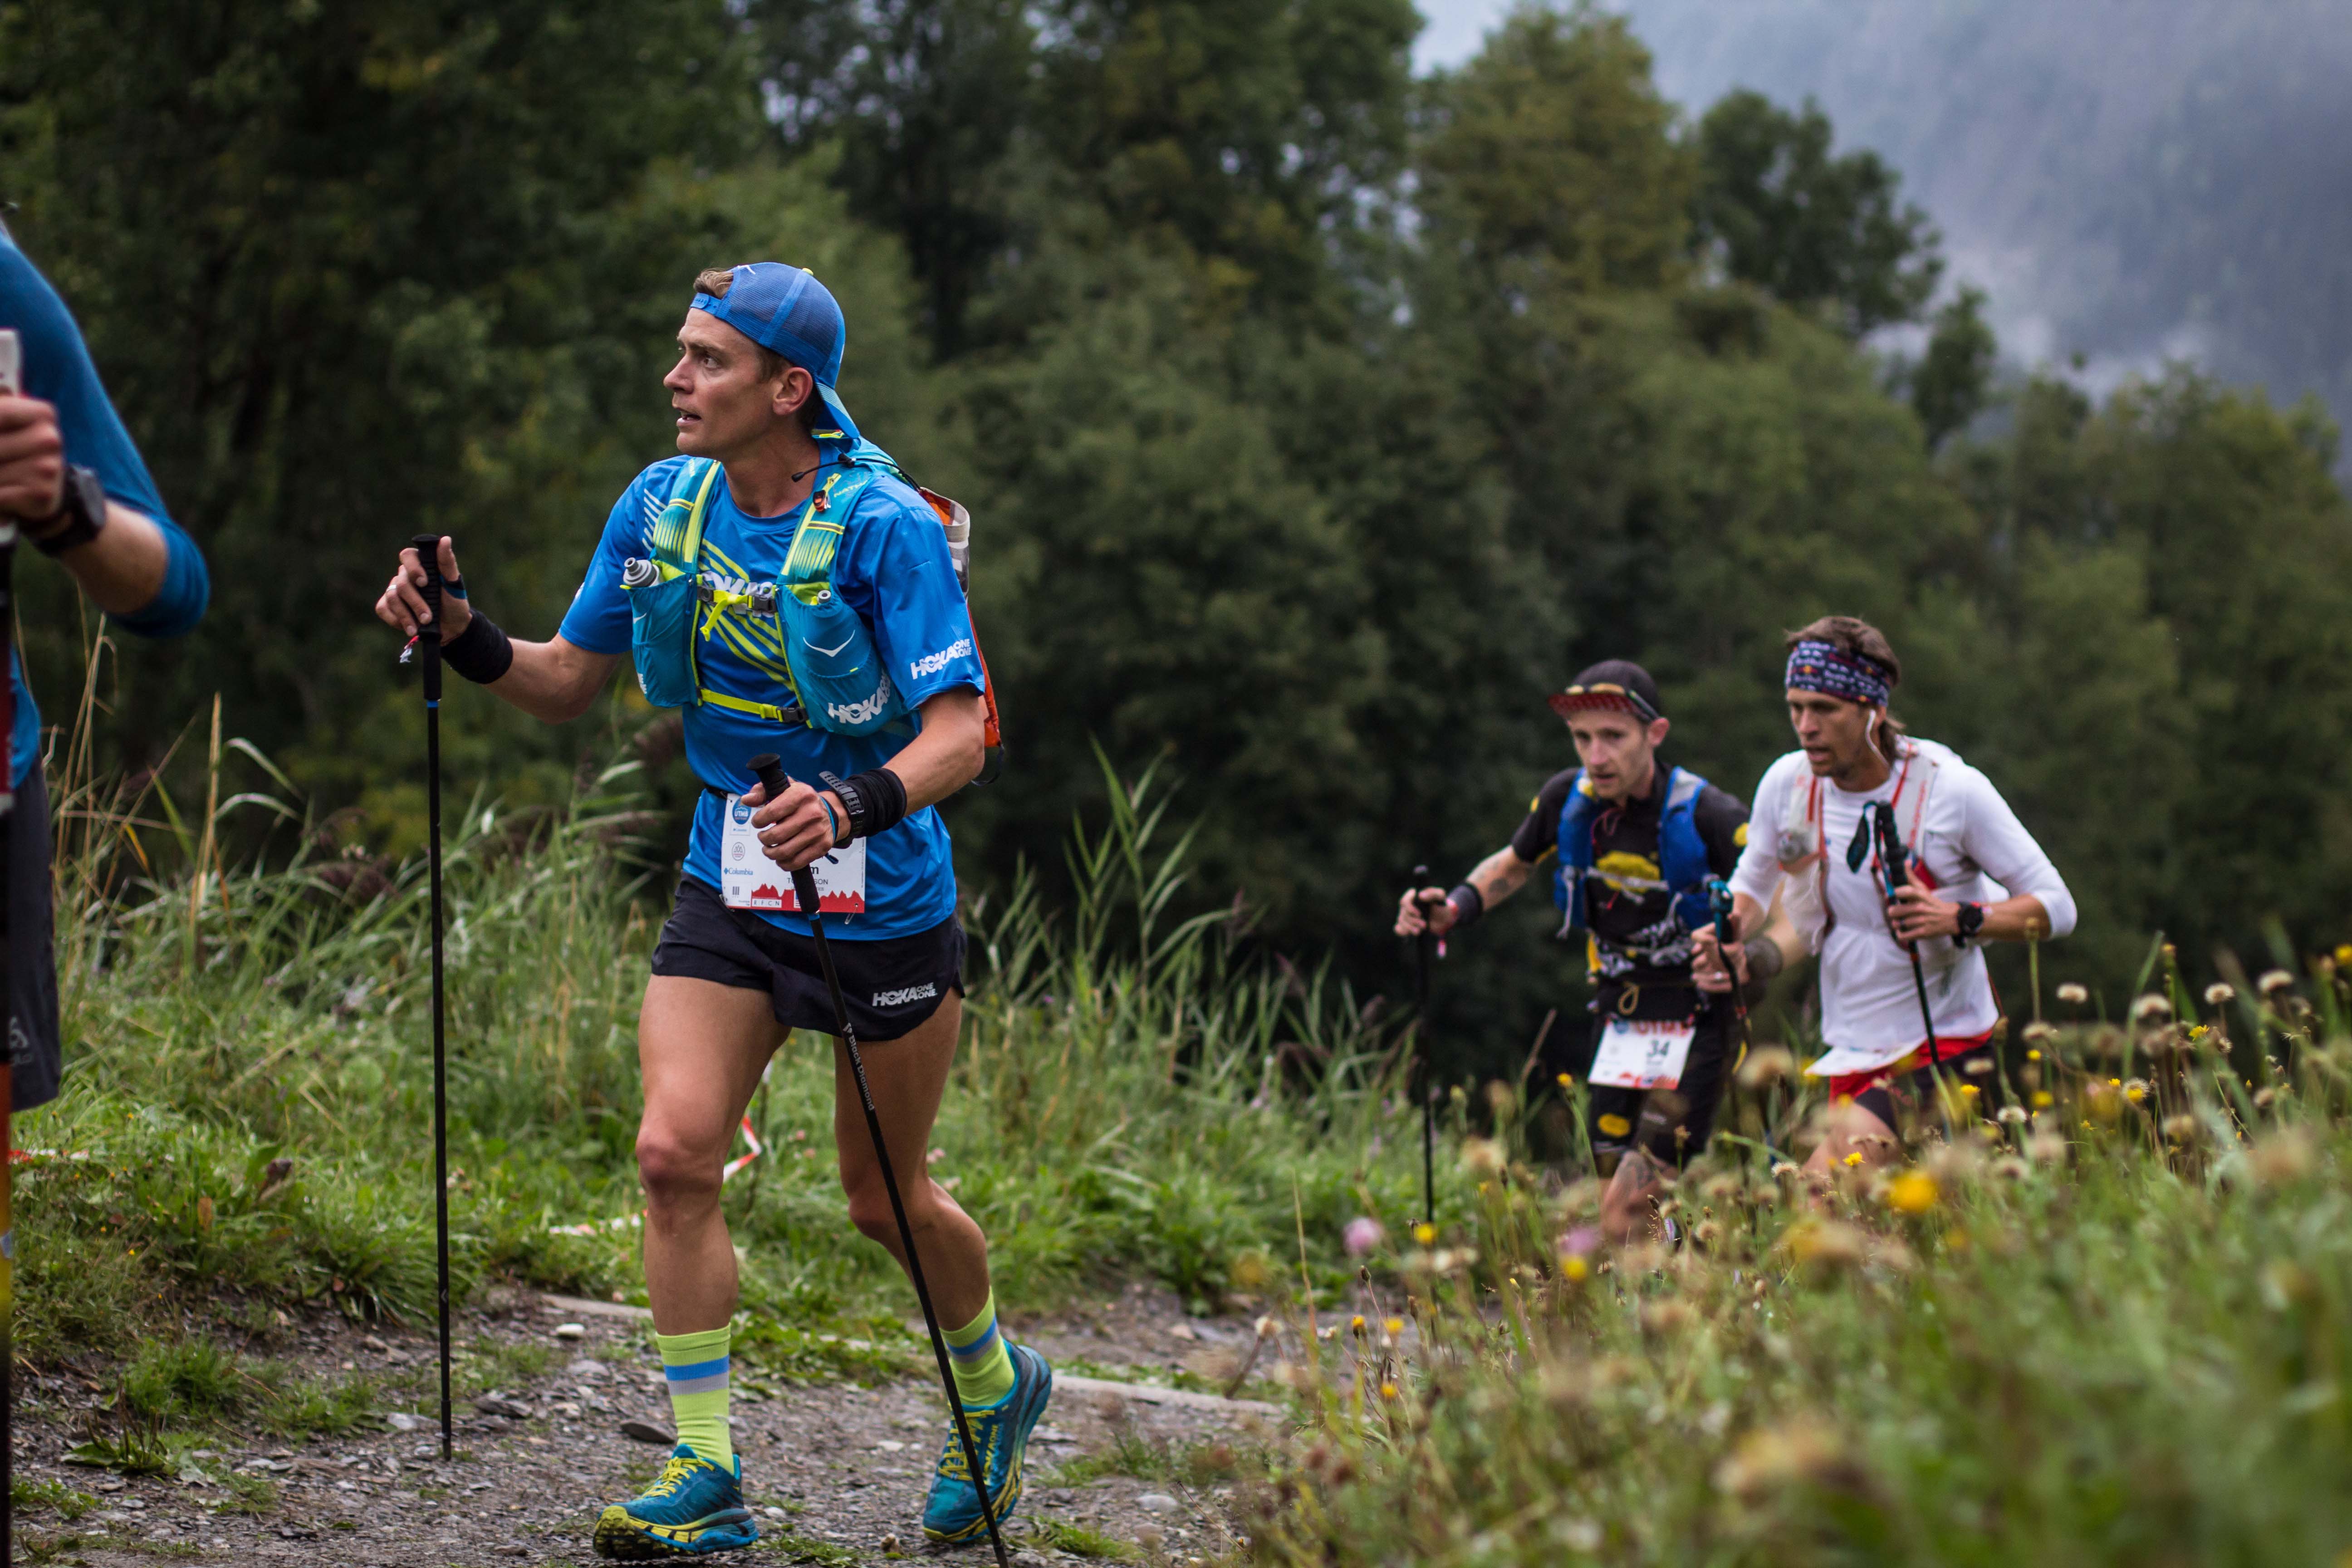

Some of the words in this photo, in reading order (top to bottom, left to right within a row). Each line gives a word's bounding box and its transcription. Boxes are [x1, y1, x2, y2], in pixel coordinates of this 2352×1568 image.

[953, 638, 970, 650] ONE
[958, 647, 972, 657] ONE
[910, 646, 960, 680] HOKA
[828, 687, 888, 724] HOKA
[916, 982, 934, 992] ONE
[917, 989, 937, 999] ONE
[872, 986, 919, 1006] HOKA
[1646, 1040, 1670, 1057] 34
[849, 1034, 861, 1065] Black
[858, 1064, 875, 1111] Diamond
